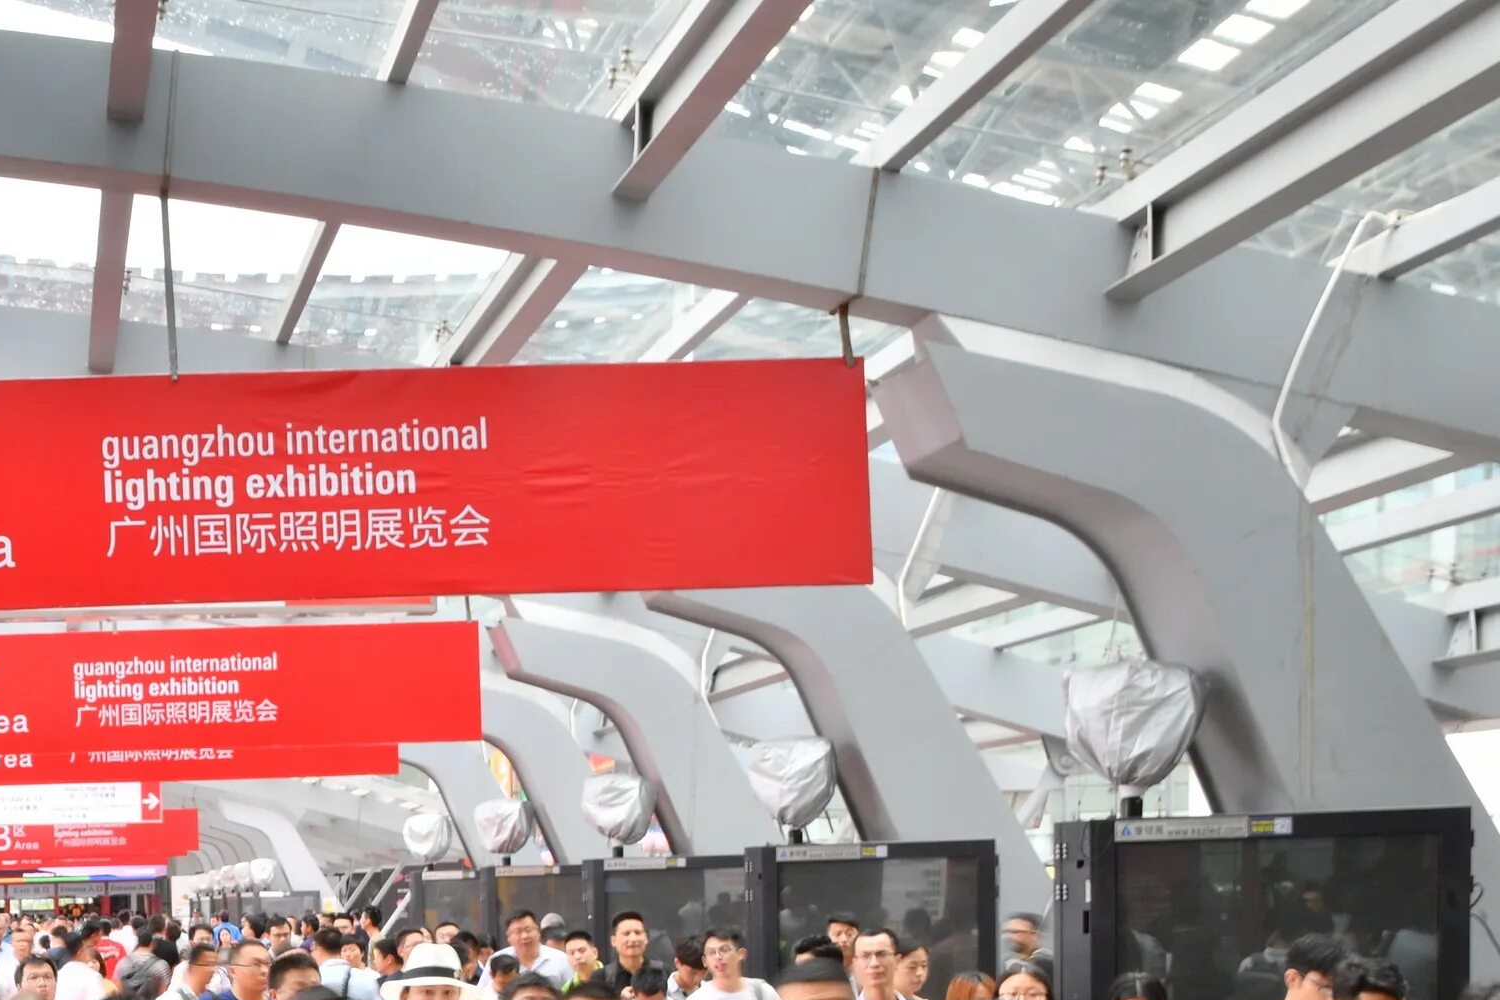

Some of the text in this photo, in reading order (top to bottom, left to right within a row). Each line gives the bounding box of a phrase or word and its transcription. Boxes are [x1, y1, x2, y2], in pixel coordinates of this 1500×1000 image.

[101, 416, 487, 467] guangzhou international
[103, 462, 416, 509] lighting exhibition
[106, 504, 490, 557] 广州国际照明展览会
[73, 651, 278, 677] guangzhou international
[74, 674, 240, 700] lighting exhibition
[75, 698, 278, 727] 广州国际照明展览会
[14, 841, 40, 850] Area
